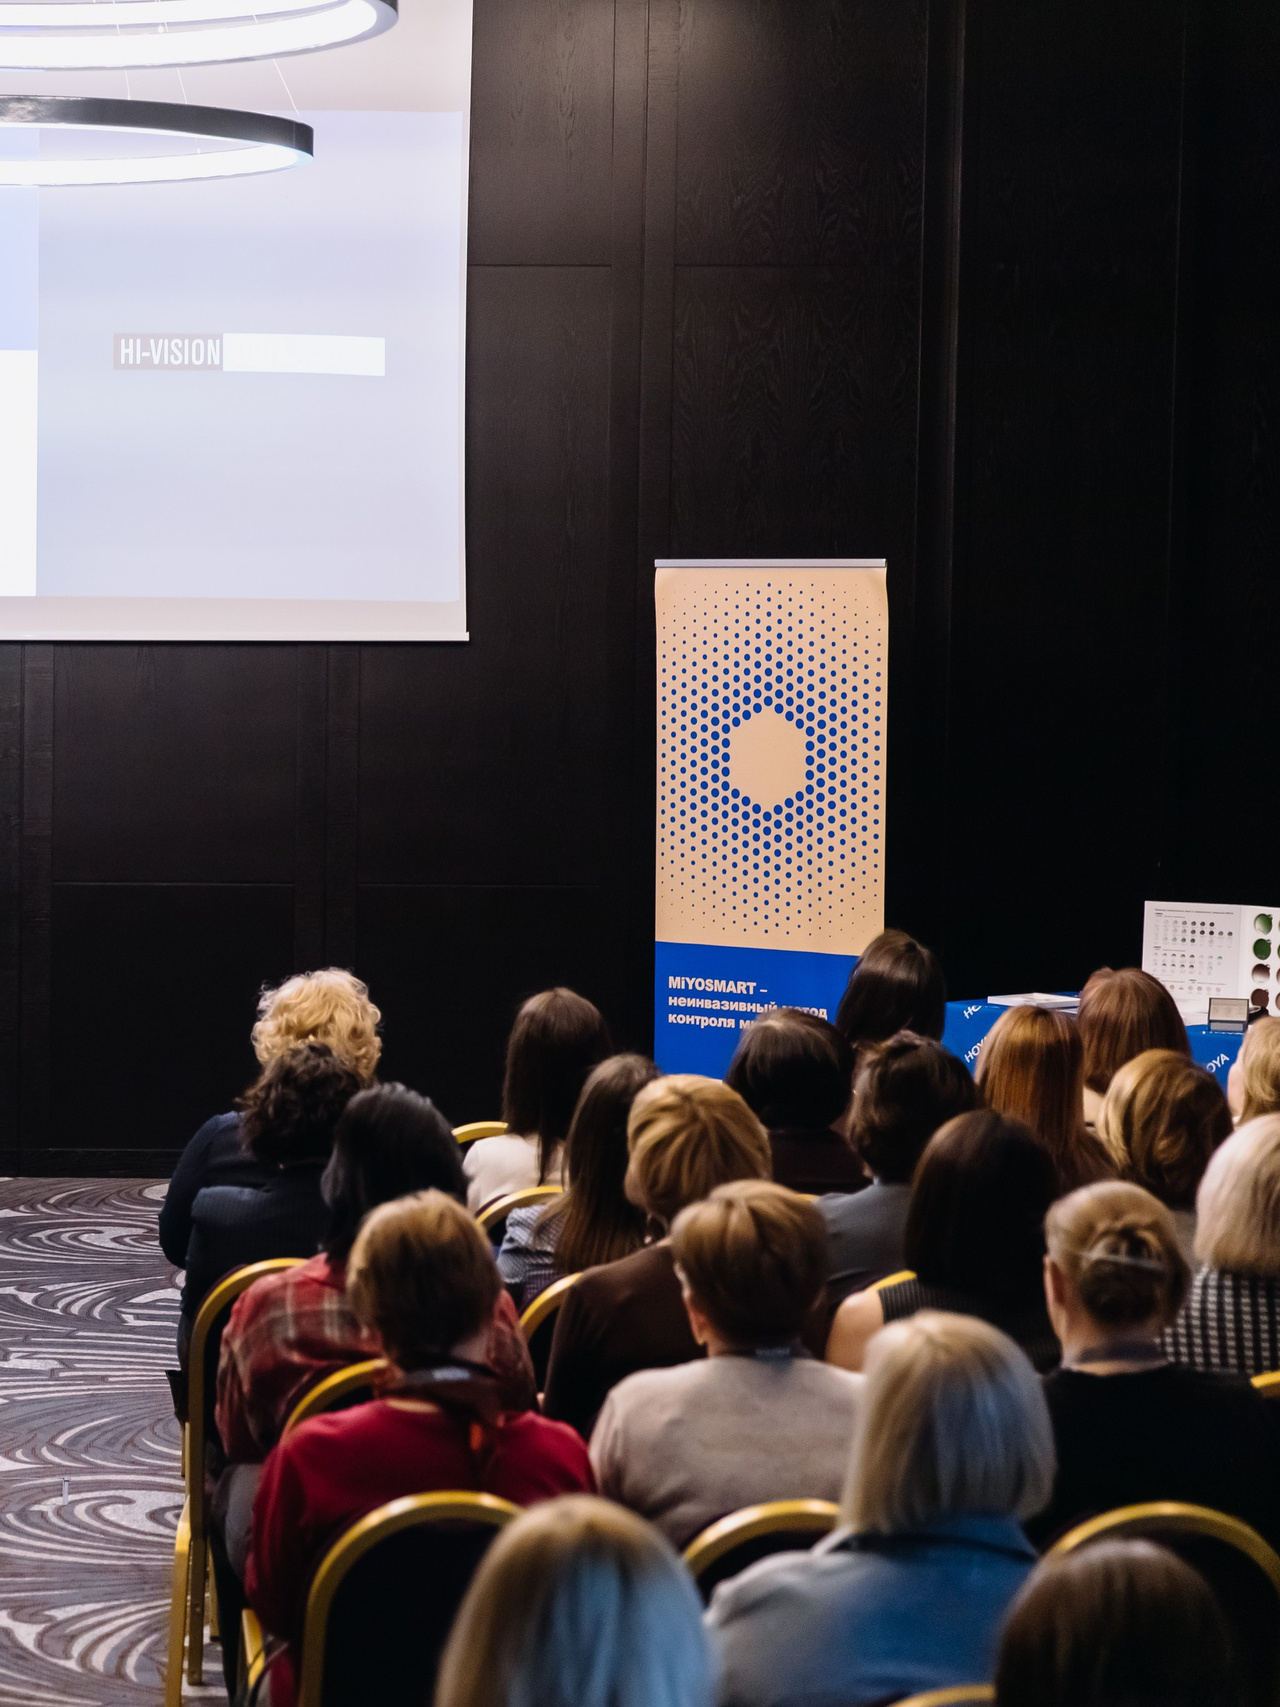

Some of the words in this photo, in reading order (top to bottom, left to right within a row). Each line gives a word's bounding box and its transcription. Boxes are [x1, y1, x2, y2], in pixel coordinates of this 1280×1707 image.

[120, 337, 220, 366] HI-VISION
[668, 975, 757, 995] MiYOSMART
[668, 996, 778, 1014] неинвазивный
[668, 1013, 736, 1029] контроля
[1206, 1053, 1230, 1073] OYA
